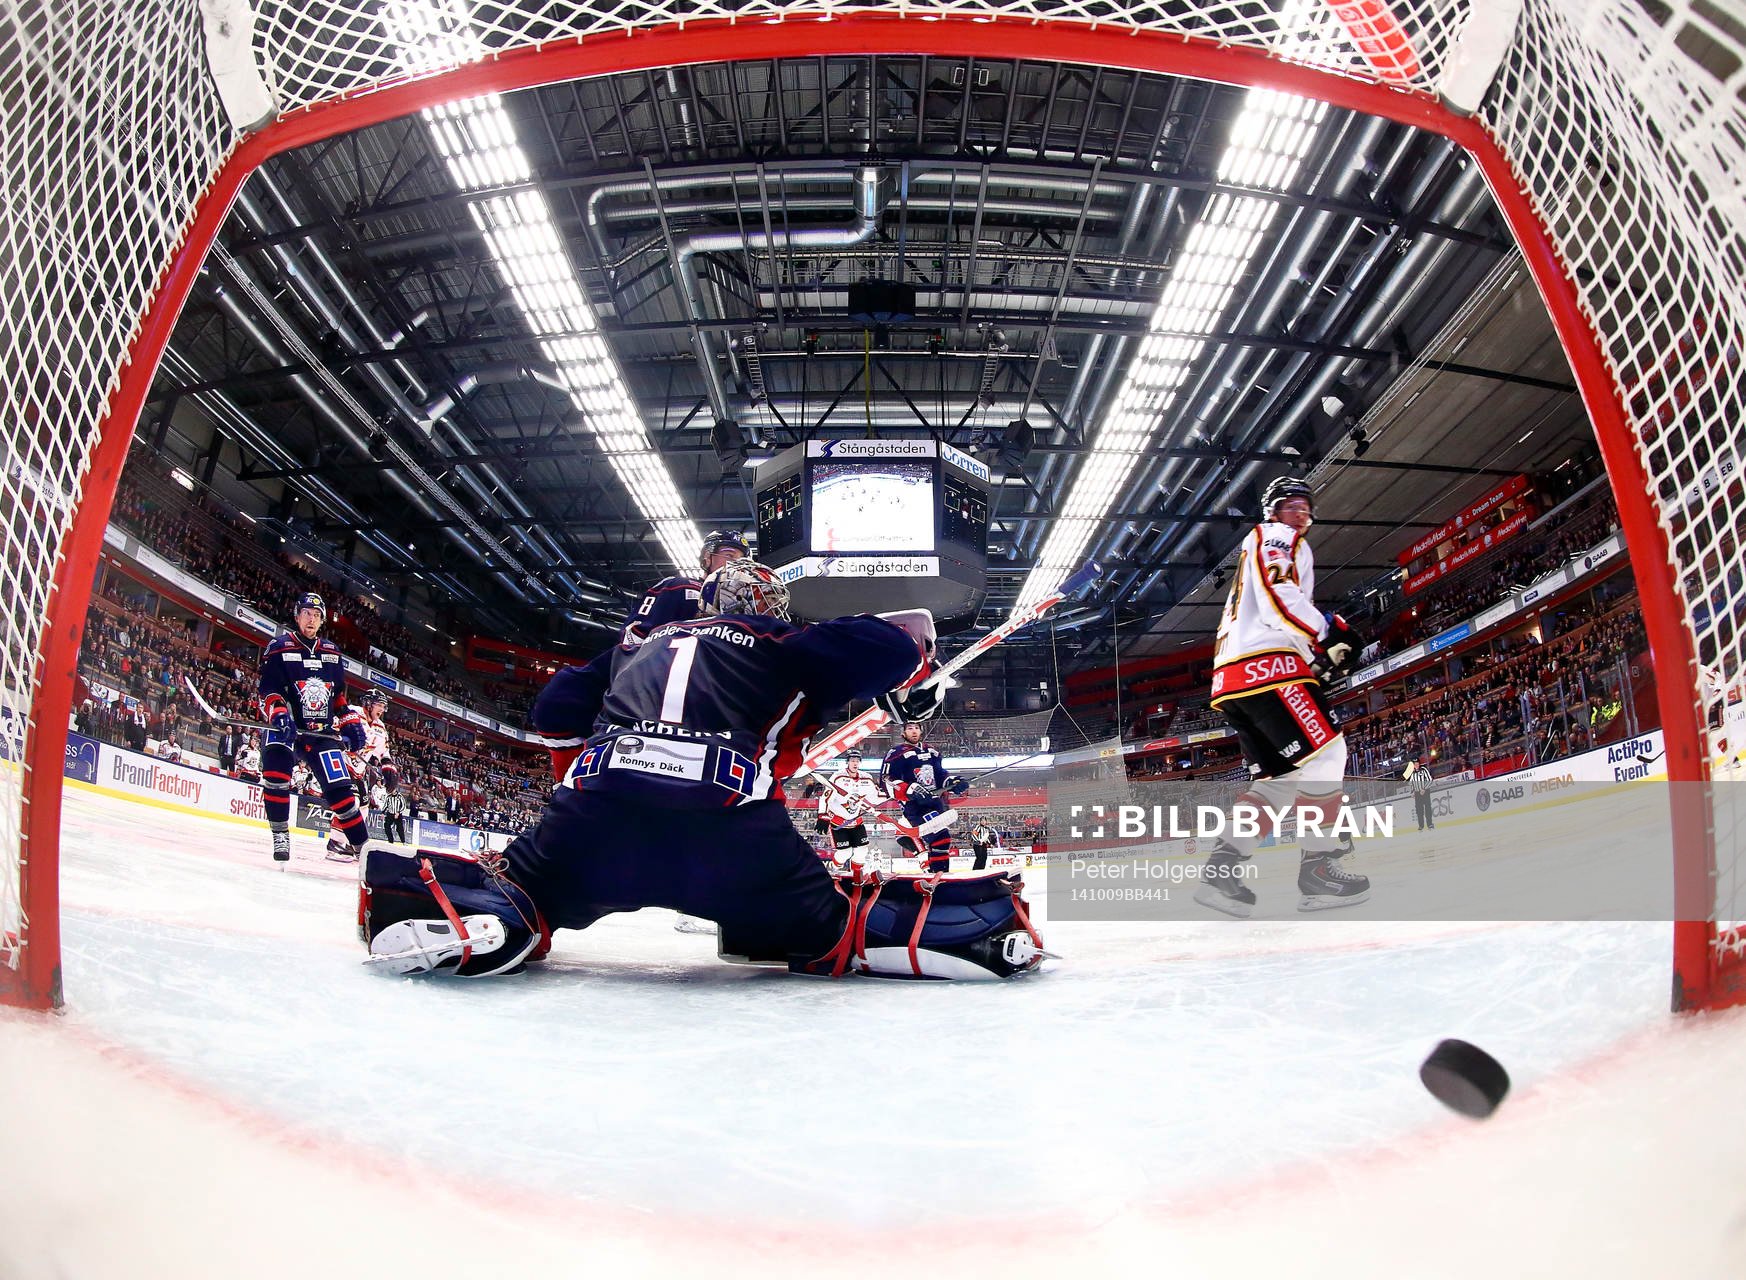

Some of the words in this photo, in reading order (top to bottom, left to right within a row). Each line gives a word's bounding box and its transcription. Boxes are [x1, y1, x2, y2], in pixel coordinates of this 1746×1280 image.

[839, 442, 926, 456] Stångåstaden
[943, 445, 988, 481] Corren
[1692, 478, 1710, 496] SB
[1472, 500, 1490, 516] Dream
[1490, 491, 1504, 504] Team
[1592, 549, 1608, 563] SAAB
[837, 560, 928, 576] Stångåstaden
[1267, 563, 1299, 586] 24
[659, 637, 699, 723] 1
[1244, 656, 1298, 683] SSAB
[1608, 740, 1653, 764] ActiPro
[619, 756, 656, 769] Ronnys
[659, 762, 685, 773] Däck
[1614, 762, 1649, 783] Event
[112, 754, 202, 804] BrandFactory
[1492, 785, 1525, 803] SAAB
[1531, 773, 1575, 796] ARENA
[248, 786, 265, 803] TEA
[230, 798, 267, 821] SPORTI
